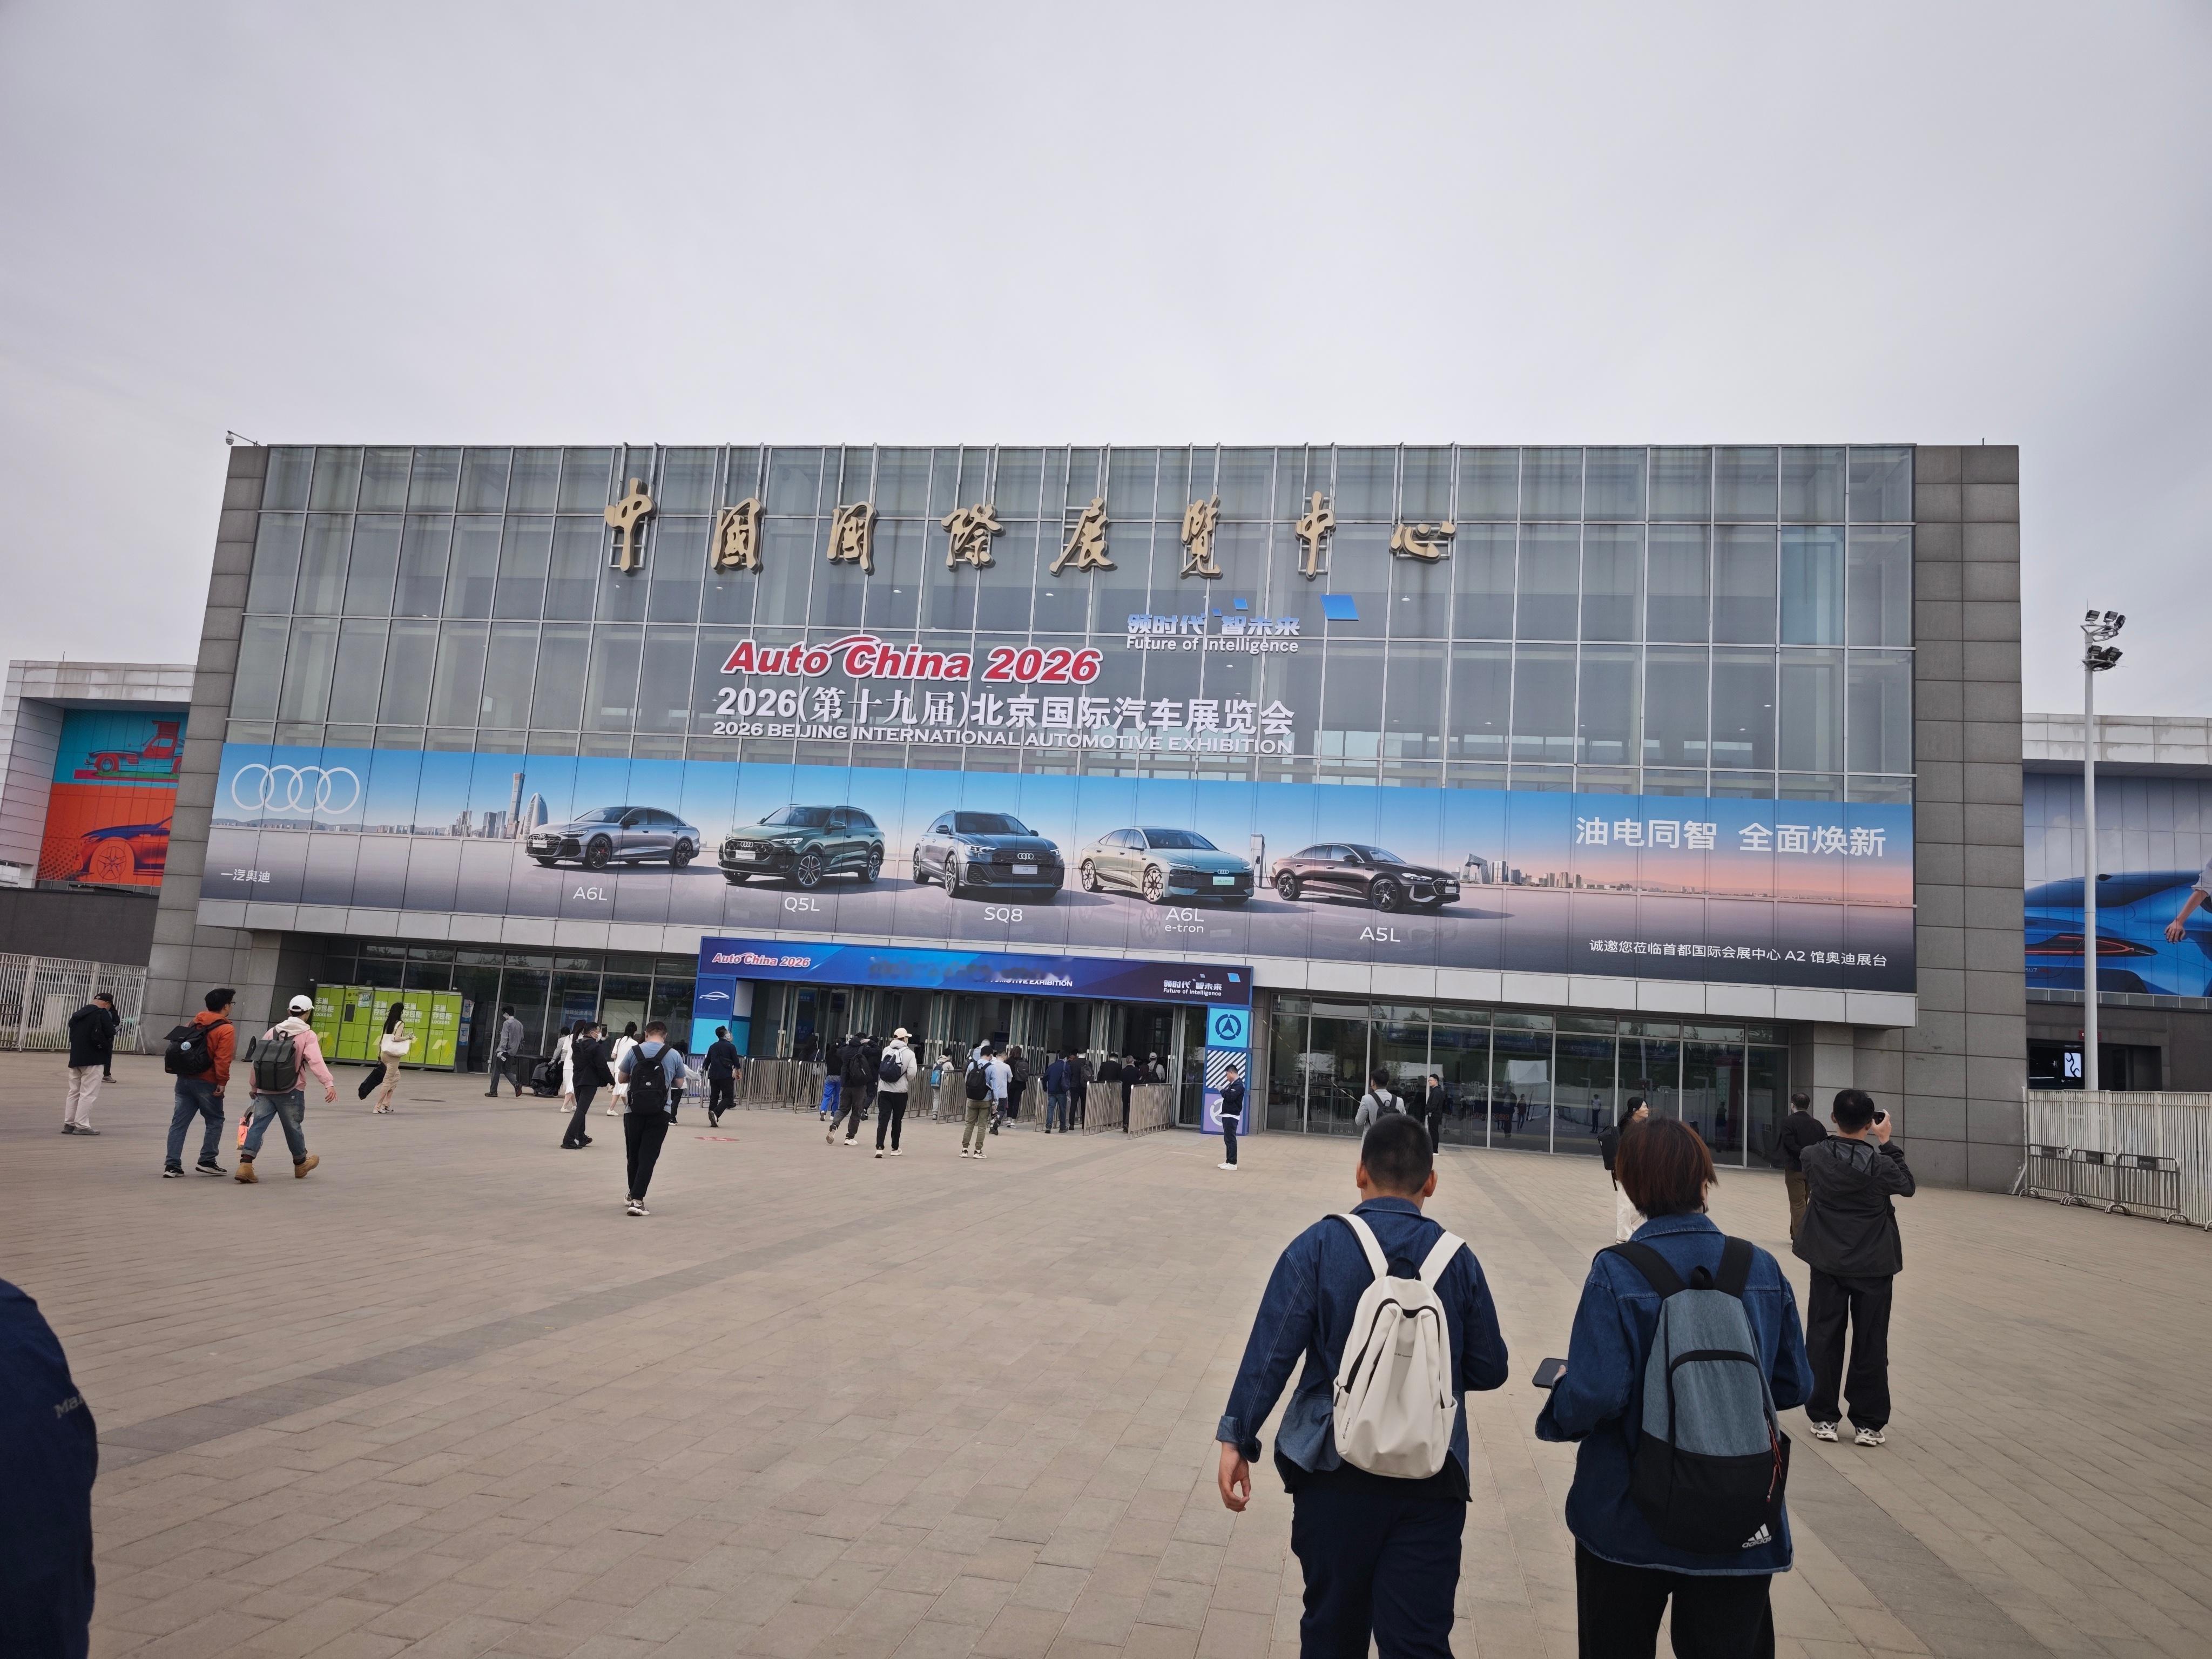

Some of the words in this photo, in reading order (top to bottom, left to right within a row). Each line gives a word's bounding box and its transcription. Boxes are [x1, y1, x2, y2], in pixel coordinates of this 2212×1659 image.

[1127, 613, 1206, 635] 领时代
[1220, 616, 1300, 636] 智未来
[1127, 636, 1177, 650] Future
[1183, 638, 1199, 650] of
[1204, 637, 1299, 655] Intelligence
[720, 639, 832, 677] Auto
[843, 637, 974, 682] China
[981, 646, 1103, 684] 2026
[712, 721, 765, 737] 2026
[767, 723, 848, 739] BEIJING
[853, 726, 1021, 746] INTERNATIONAL
[1024, 731, 1163, 751] AUTOMOTIVE
[1168, 737, 1293, 754] EXHIBITION
[1575, 817, 1717, 850] 油电同智
[1738, 822, 1886, 857] 全面焕新
[220, 868, 271, 884] 一汽奥迪
[572, 886, 608, 901] A6L
[784, 896, 820, 912] Q5L
[983, 907, 1023, 922] SQ8
[1165, 907, 1205, 922] A6L
[1164, 923, 1204, 934] e-tron
[1359, 926, 1401, 943] A5L
[712, 953, 741, 964] Auto
[744, 953, 778, 966] China
[779, 956, 811, 967] 2026
[1589, 939, 1781, 961] 诚邀您莅临首都国际会展中心
[1784, 950, 1806, 962] A2
[1810, 950, 1887, 967] 馆奥迪展台
[1163, 980, 1191, 988] 领时代
[1742, 1535, 1771, 1548] adidas
